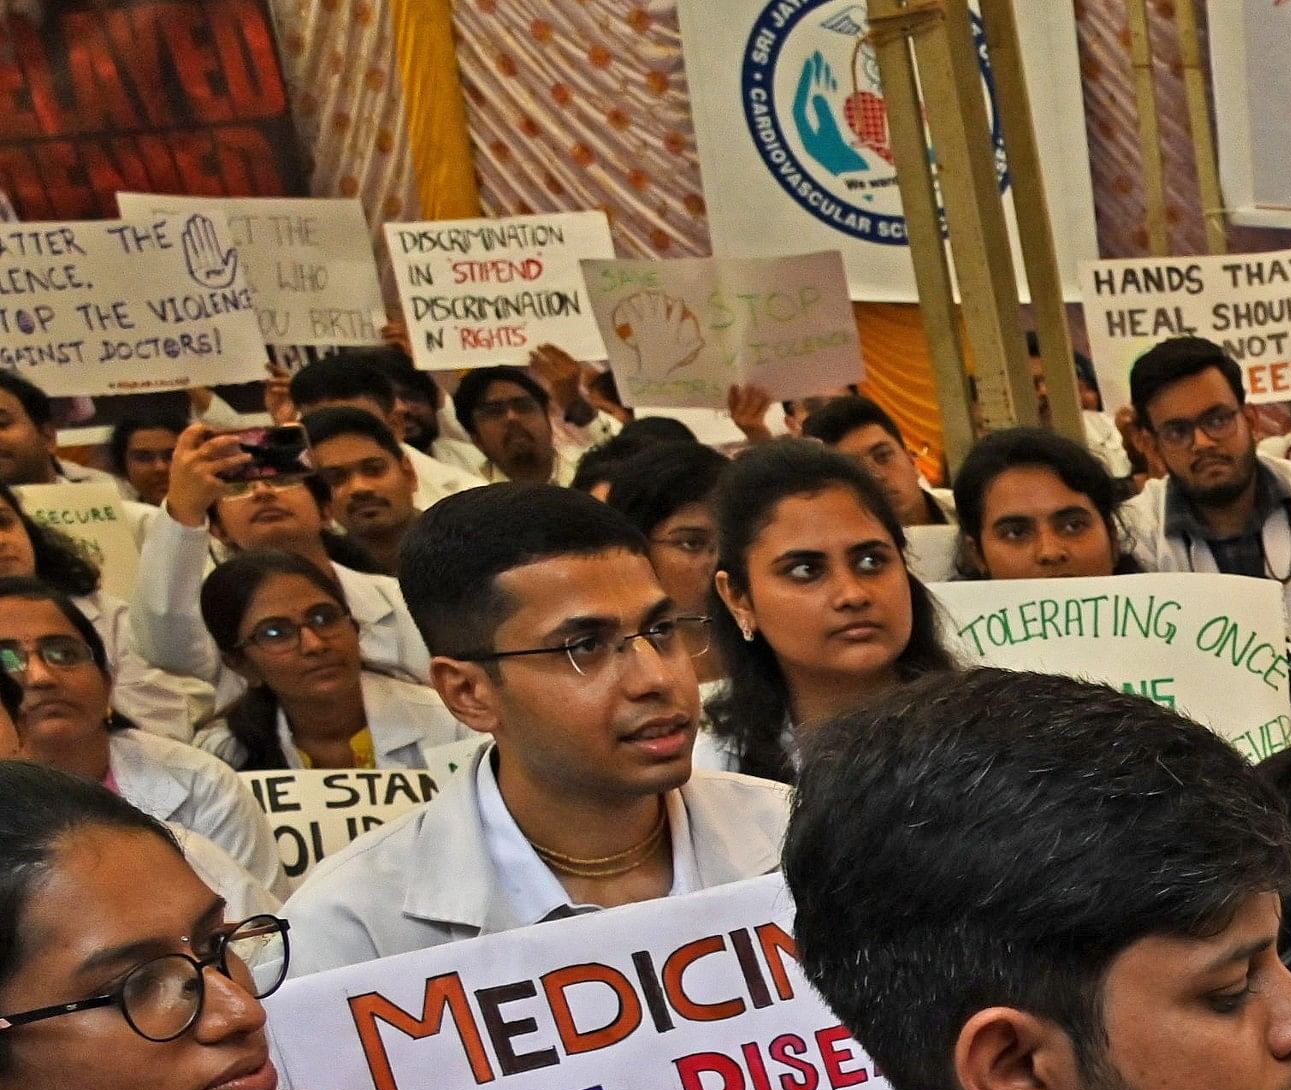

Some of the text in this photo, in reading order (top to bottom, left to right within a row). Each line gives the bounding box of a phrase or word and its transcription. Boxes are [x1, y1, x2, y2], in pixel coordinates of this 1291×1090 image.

[752, 28, 777, 65] SRI
[750, 87, 873, 234] CARDIOVASCULAR
[106, 219, 174, 254] THE
[407, 263, 434, 287] IN
[1093, 264, 1204, 295] HANDS
[76, 301, 135, 332] THE
[1105, 306, 1198, 338] HEAL
[426, 328, 444, 352] IN
[1222, 331, 1289, 361] NOT
[35, 505, 118, 527] SECURE
[957, 594, 1182, 657] TOLERATING
